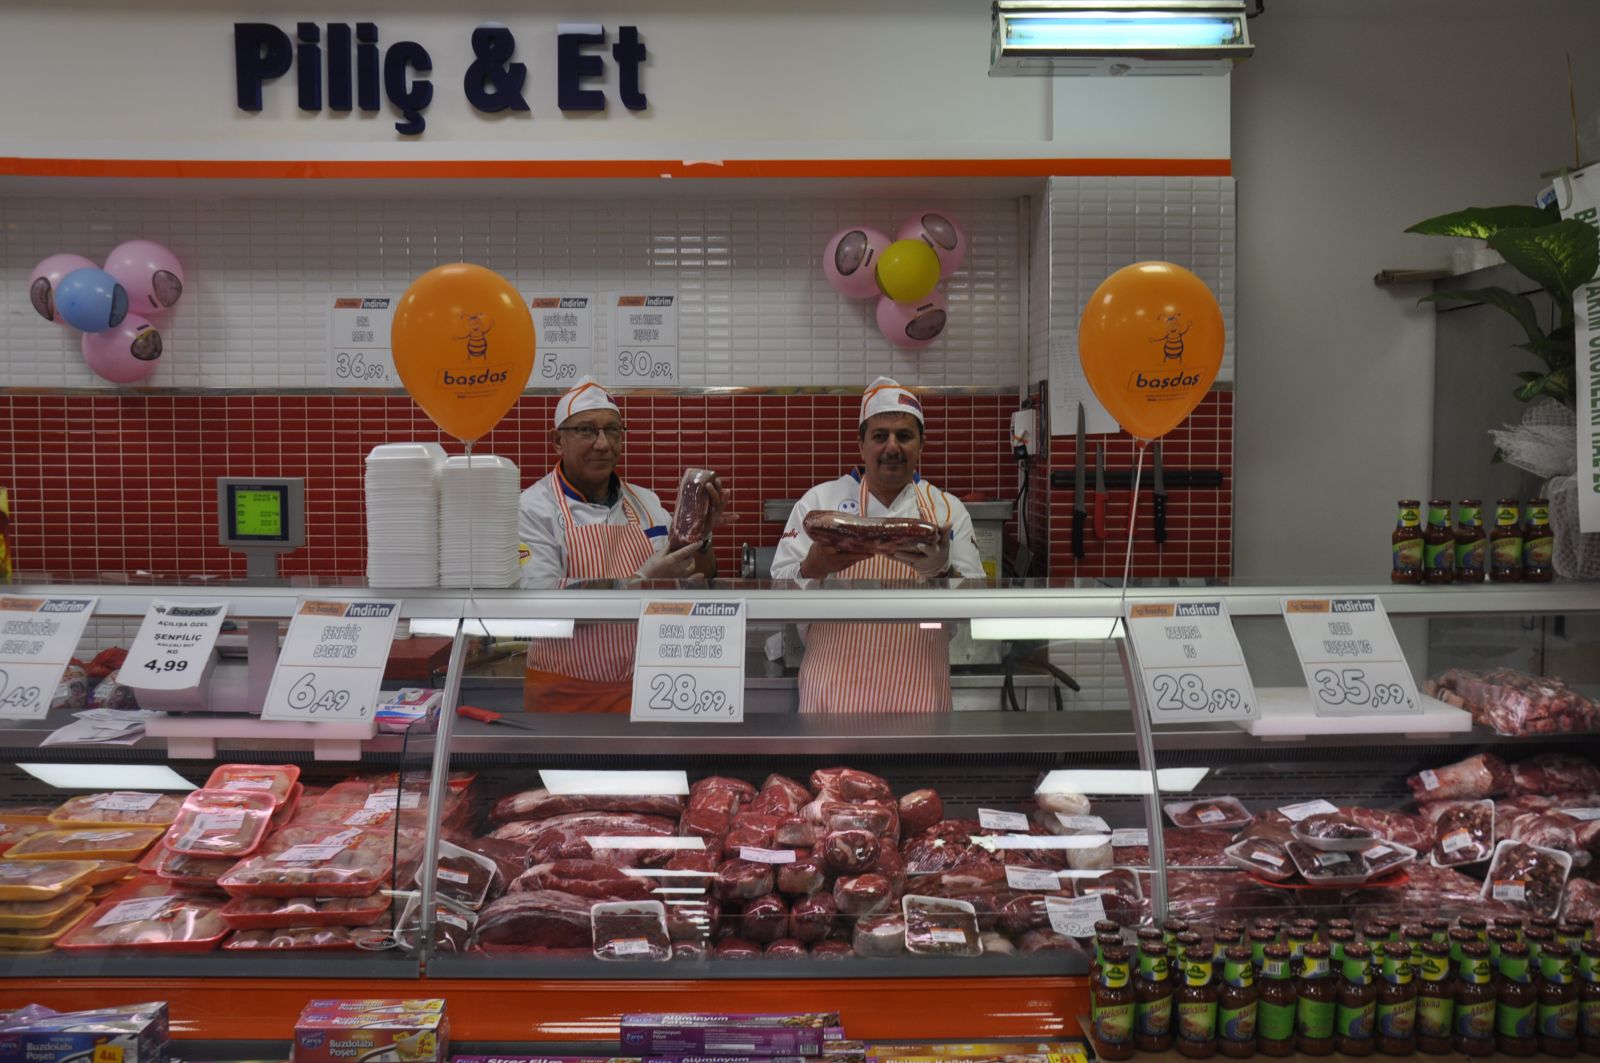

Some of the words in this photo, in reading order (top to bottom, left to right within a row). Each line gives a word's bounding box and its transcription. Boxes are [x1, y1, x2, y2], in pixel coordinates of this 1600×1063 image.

[234, 22, 433, 135] Piliç
[464, 21, 531, 113] &
[558, 23, 647, 111] Et
[336, 352, 384, 380] 36,99
[542, 353, 577, 380] 5,99
[618, 351, 670, 378] 30,99
[45, 601, 86, 612] indirim
[350, 603, 390, 616] indirim
[696, 603, 736, 616] indirim
[1178, 603, 1217, 616] indirim
[1333, 600, 1374, 612] indirim
[154, 633, 202, 641] ŞENPİLİÇ
[659, 624, 684, 639] DANA
[689, 625, 725, 642] KUŞBAŞI
[659, 644, 681, 658] ORTA
[683, 641, 708, 658] YAĞLI
[709, 644, 722, 658] KG
[144, 660, 188, 673] 4,99
[287, 672, 350, 713] 6,49
[649, 673, 726, 714] 28,99
[1153, 673, 1241, 714] 28,99
[1315, 668, 1404, 708] 35,99
[27, 1043, 73, 1051] Buzdolabı
[330, 1040, 373, 1048] Buzdolabı
[330, 1048, 356, 1057] Poşeti
